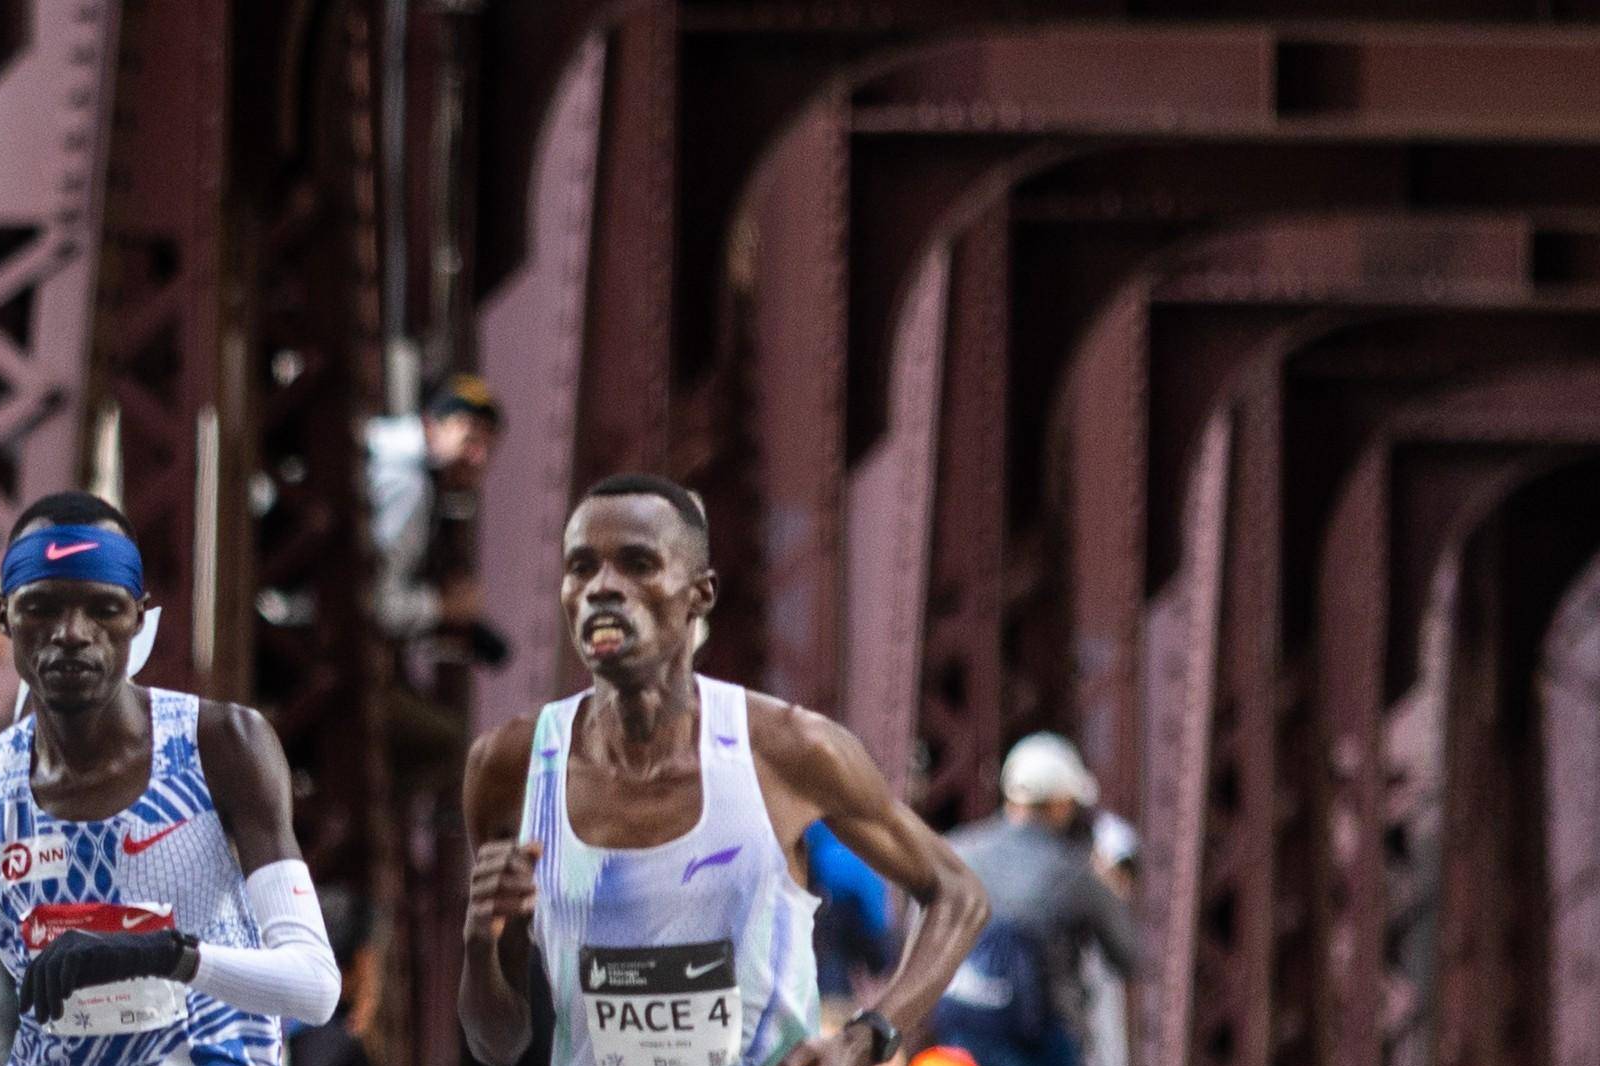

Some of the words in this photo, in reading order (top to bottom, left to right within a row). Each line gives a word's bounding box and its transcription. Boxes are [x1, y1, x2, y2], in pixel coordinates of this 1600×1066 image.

[39, 848, 64, 863] NN
[595, 1000, 695, 1032] PACE
[708, 996, 732, 1028] 4
